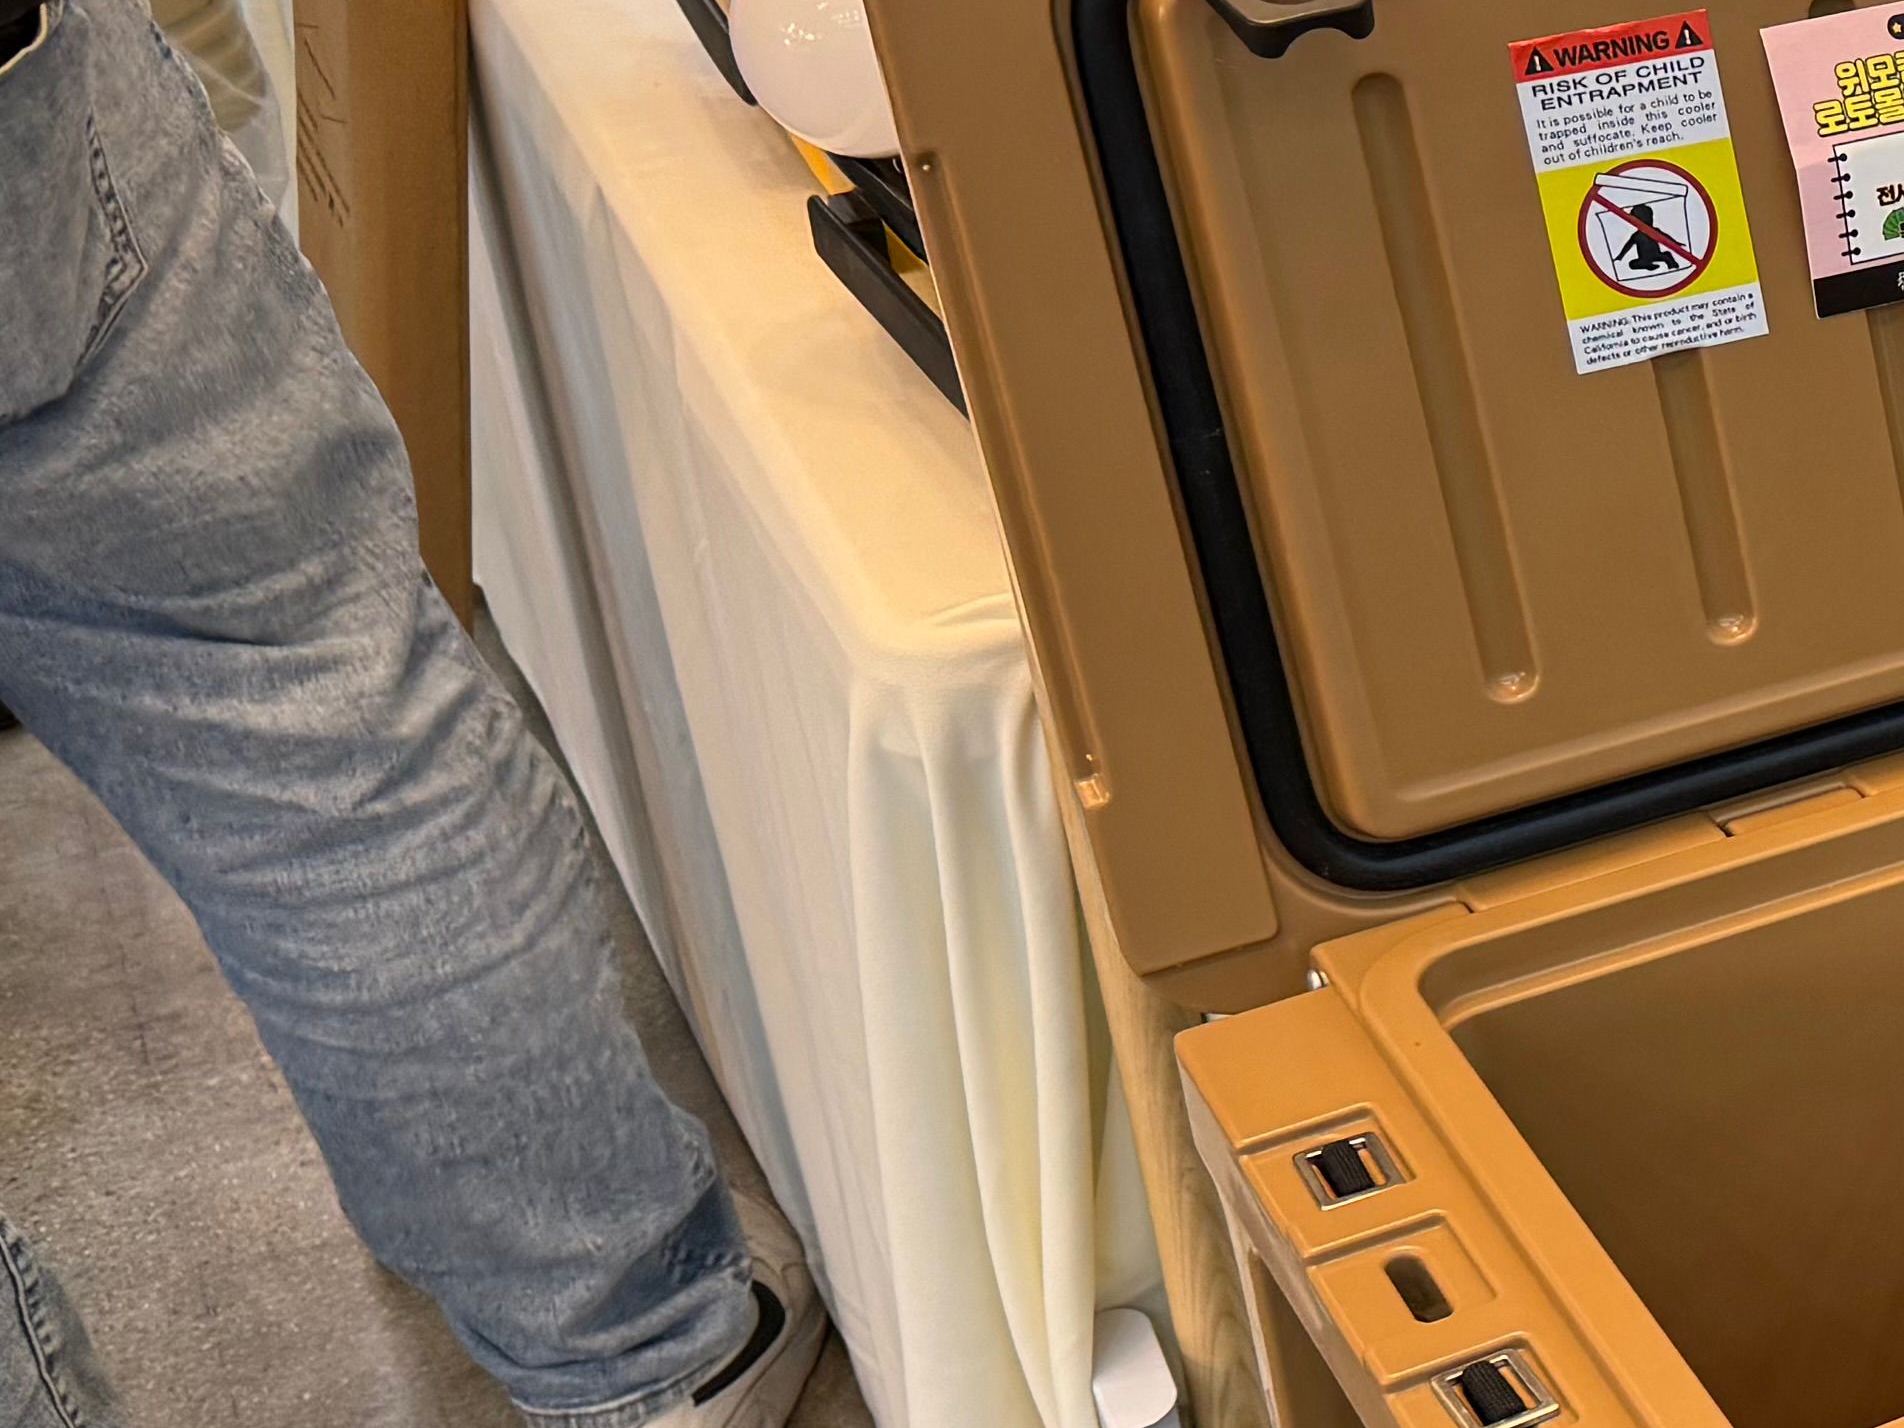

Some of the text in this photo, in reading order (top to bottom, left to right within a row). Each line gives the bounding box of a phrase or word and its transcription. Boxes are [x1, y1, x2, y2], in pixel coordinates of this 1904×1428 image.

[1553, 32, 1670, 68] WARNING
[1532, 56, 1705, 97] RISK OF CHILD
[1541, 71, 1702, 111] ENTRAPMENT
[1536, 90, 1713, 129] It is possible for a child to be
[1539, 101, 1716, 142] trapped inside this cooler
[1541, 141, 1564, 153] and
[1641, 122, 1673, 135] Keep
[1681, 113, 1717, 127] cooler
[1544, 153, 1565, 165] out
[1568, 149, 1581, 162] of
[1584, 138, 1643, 158] children's
[1582, 329, 1624, 344] chemical
[1712, 306, 1736, 317] State
[1632, 313, 1652, 323] This
[1654, 304, 1689, 320] product
[1712, 294, 1746, 306] contain
[1584, 340, 1629, 355] California
